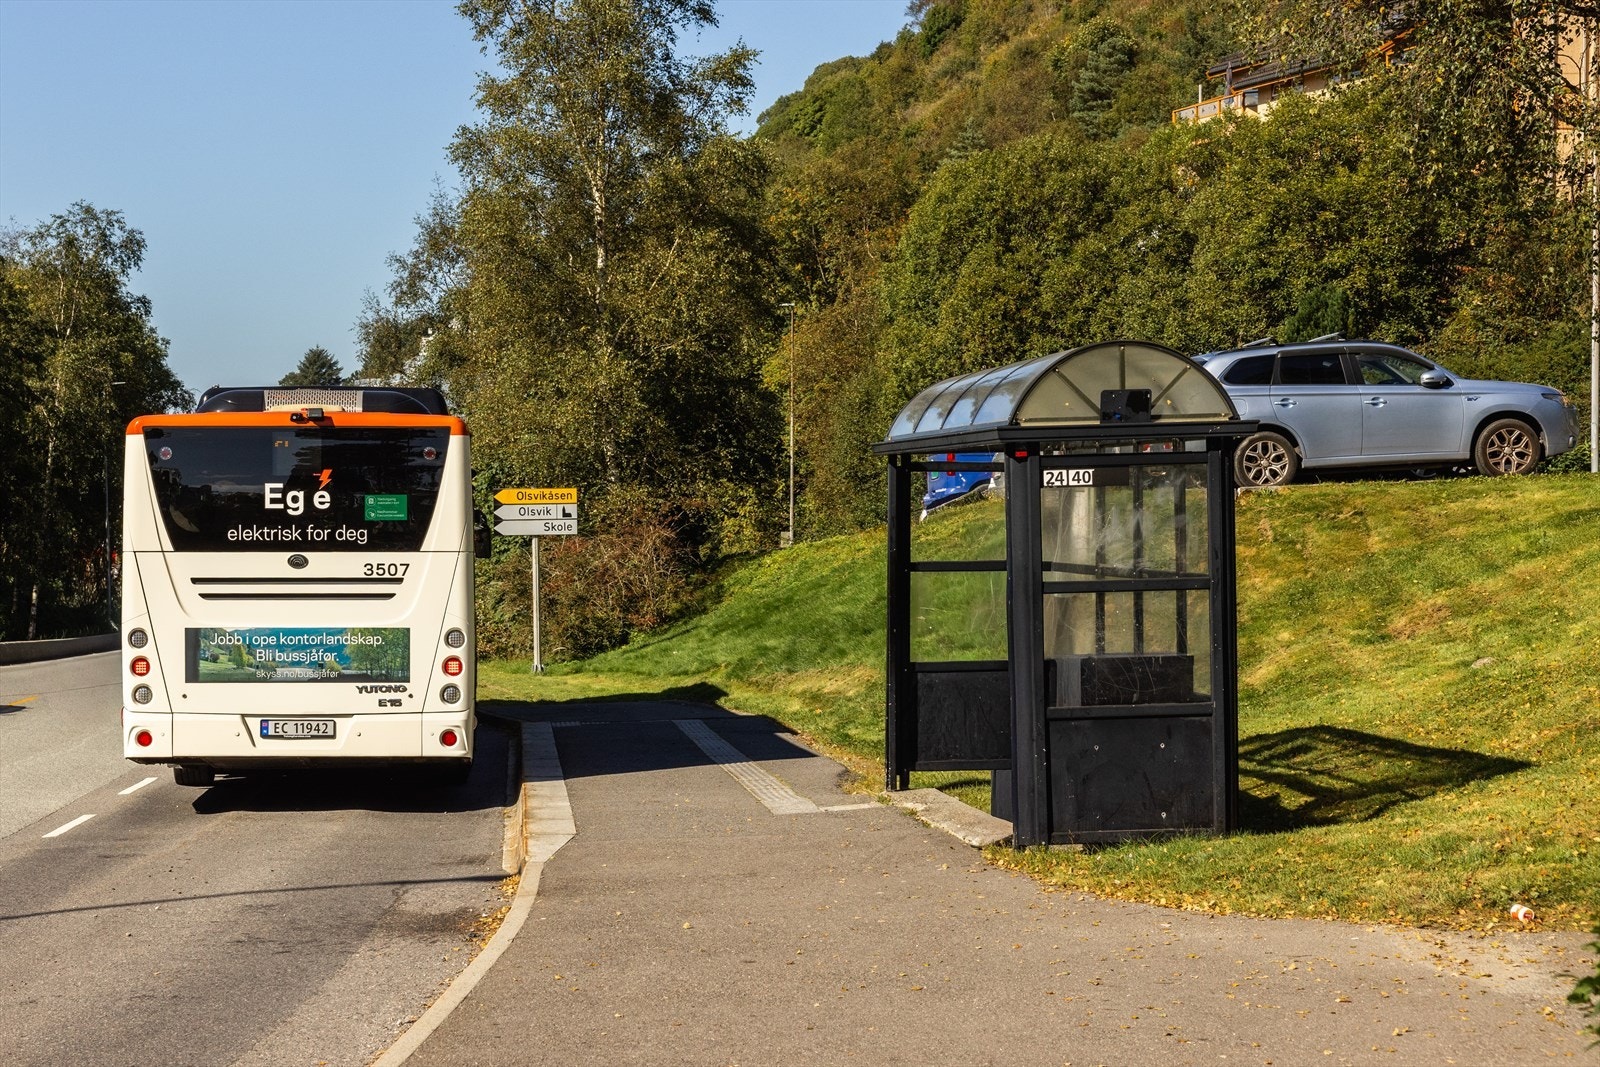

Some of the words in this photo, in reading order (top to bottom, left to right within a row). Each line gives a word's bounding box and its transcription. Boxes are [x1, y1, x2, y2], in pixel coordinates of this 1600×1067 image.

[1046, 471, 1064, 486] 24
[1072, 470, 1091, 484] 40
[264, 482, 305, 516] Eg
[516, 491, 573, 501] Olsvikåsen
[518, 506, 552, 517] Olsvik
[543, 522, 573, 532] Skole
[227, 524, 302, 541] elektrisk
[306, 524, 331, 541] for
[335, 524, 368, 545] deg
[363, 563, 410, 577] 3507
[209, 632, 243, 645] Jobb
[246, 633, 249, 645] i
[252, 635, 277, 647] ope
[279, 632, 385, 648] kontorlandskap.
[256, 649, 272, 662] Bli
[275, 648, 339, 664] bussjåfør.
[256, 669, 340, 680] skyss.no/bussjåfør
[355, 684, 408, 694] YUTONG
[274, 722, 288, 734] EC
[293, 722, 329, 734] 11942
